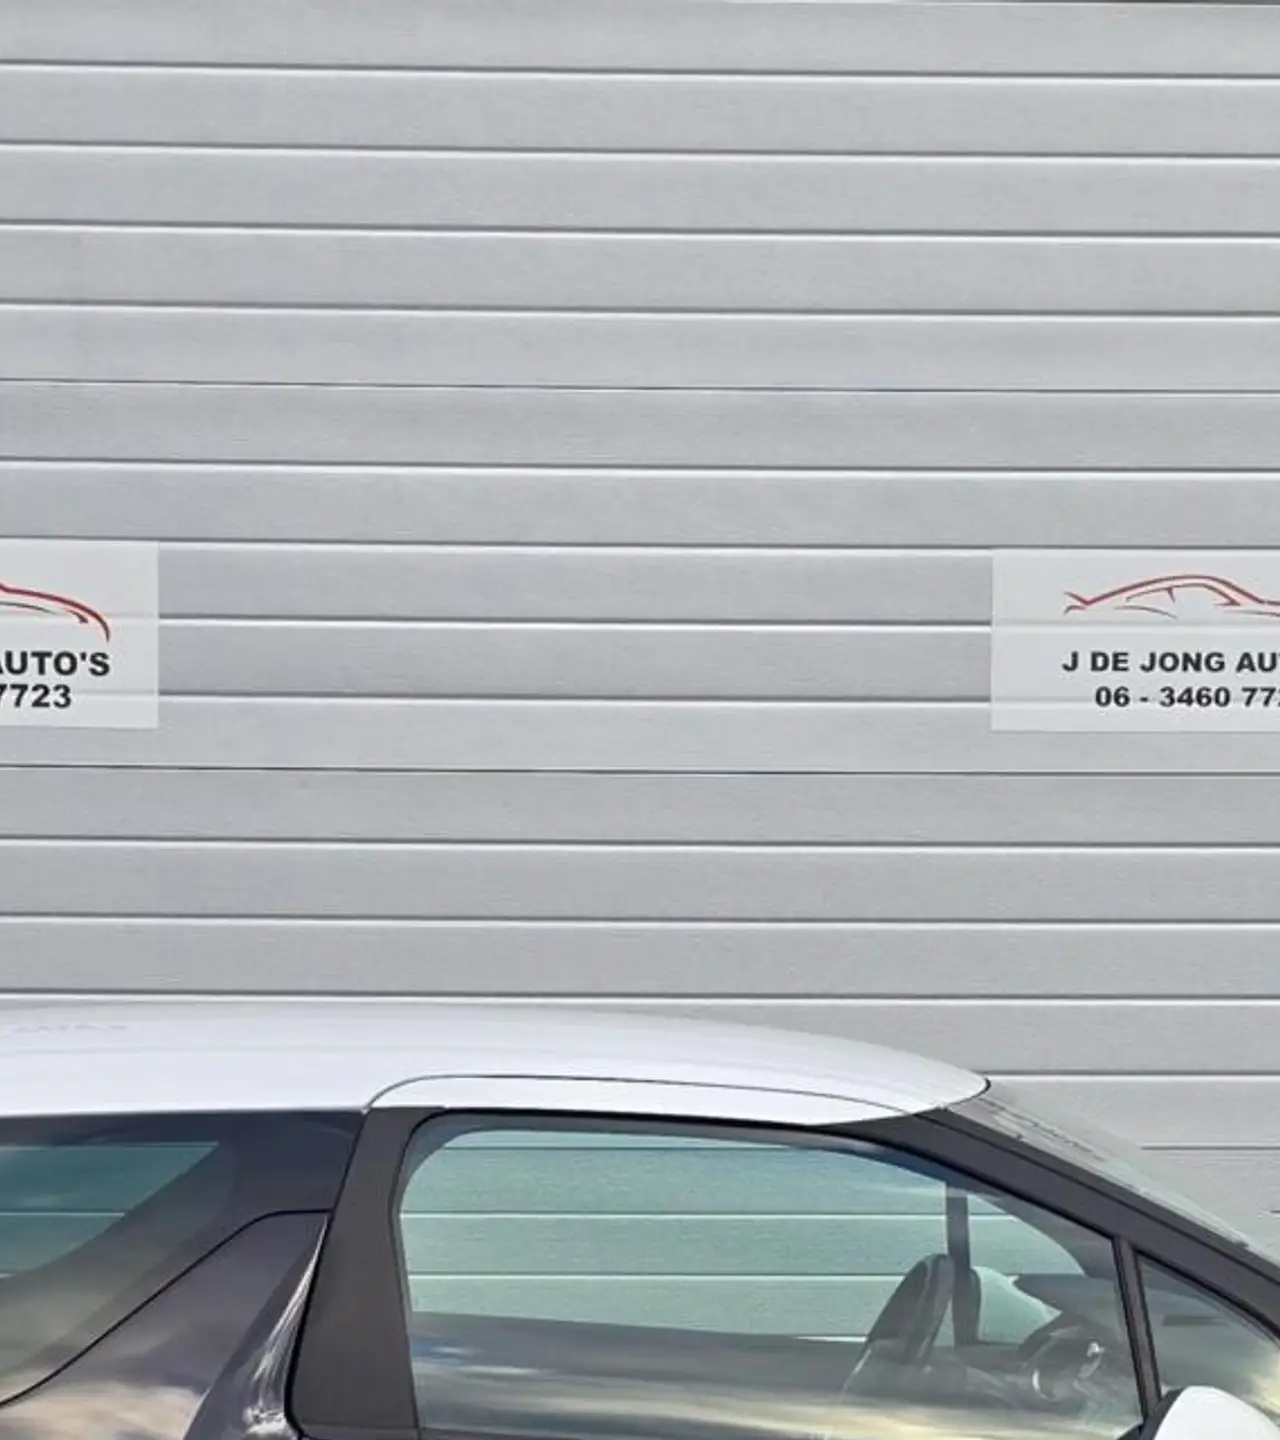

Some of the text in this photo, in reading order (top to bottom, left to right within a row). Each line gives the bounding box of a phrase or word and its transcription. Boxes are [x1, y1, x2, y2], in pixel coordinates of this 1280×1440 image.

[1062, 651, 1079, 672] J
[1090, 651, 1129, 672] DE
[1139, 652, 1225, 673] JONG
[1095, 686, 1131, 707] 06
[1160, 686, 1231, 707] 3460
